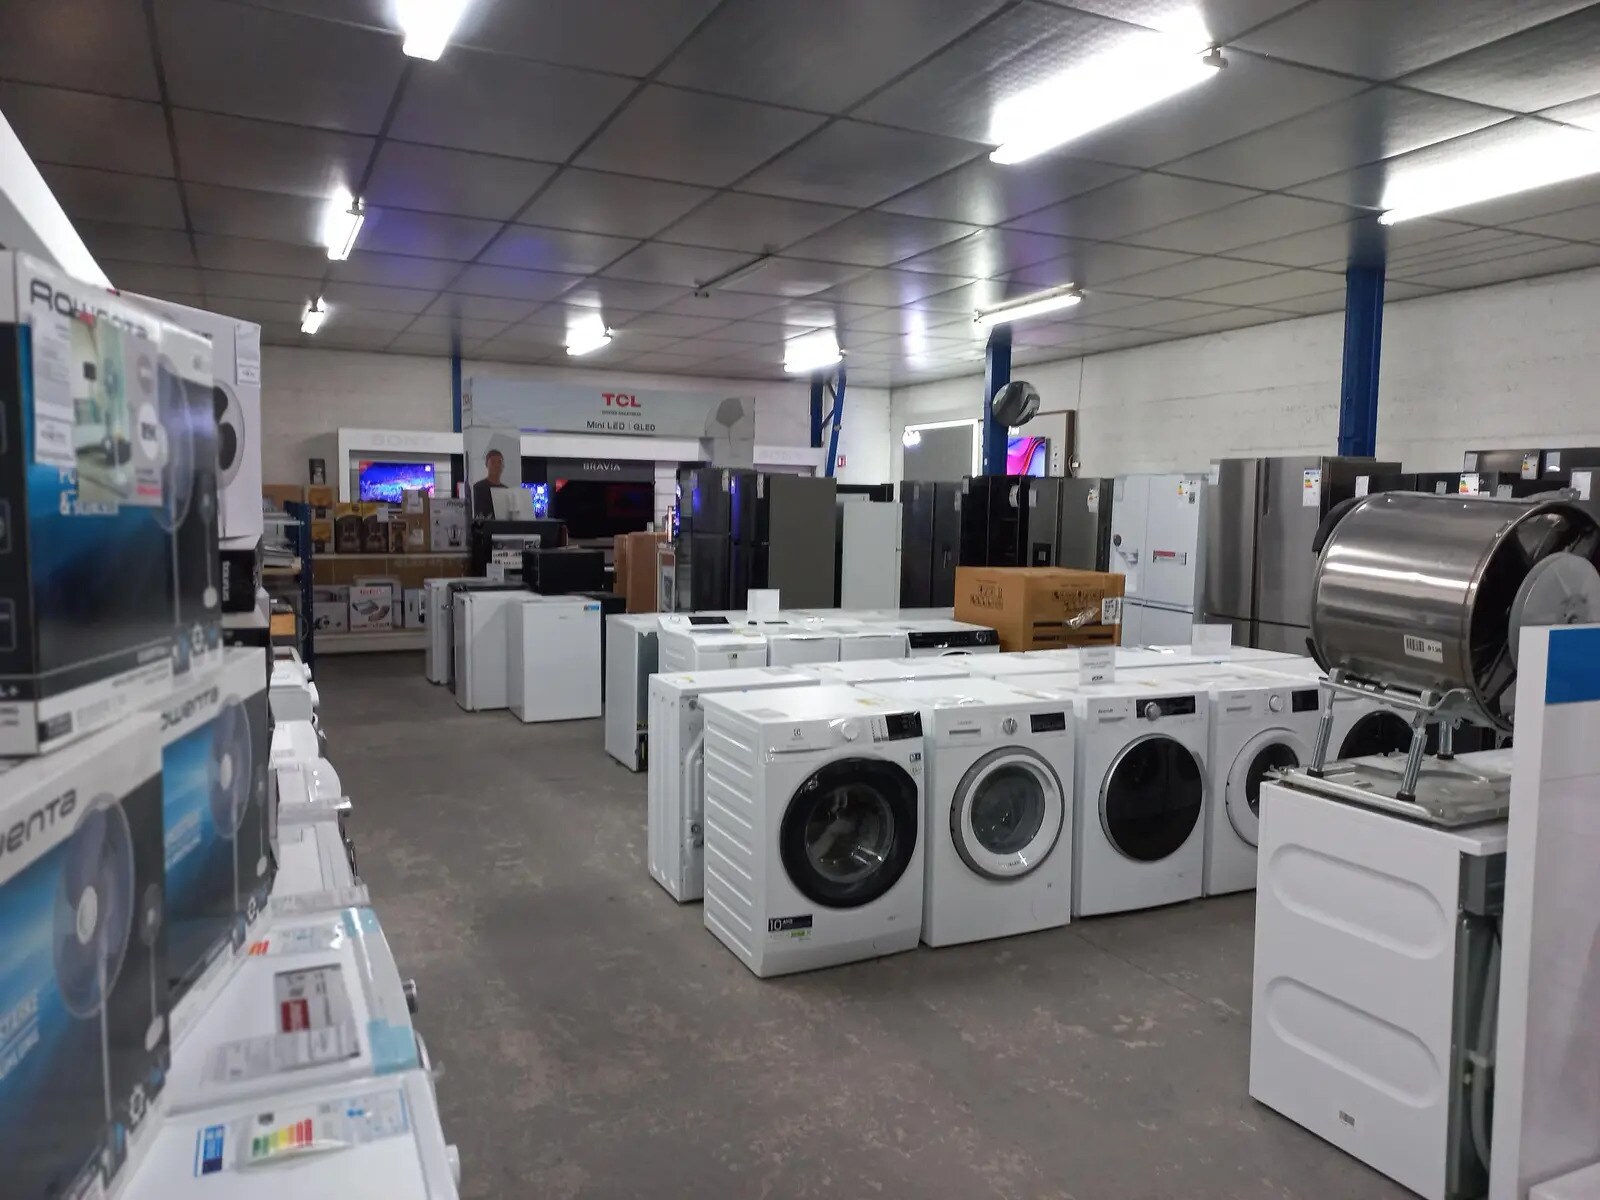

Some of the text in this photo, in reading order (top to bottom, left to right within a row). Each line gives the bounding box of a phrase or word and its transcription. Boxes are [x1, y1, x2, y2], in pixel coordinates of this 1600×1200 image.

[602, 393, 641, 408] TCL
[586, 420, 656, 432] Mini LED QLED
[583, 463, 621, 472] BRAVIA
